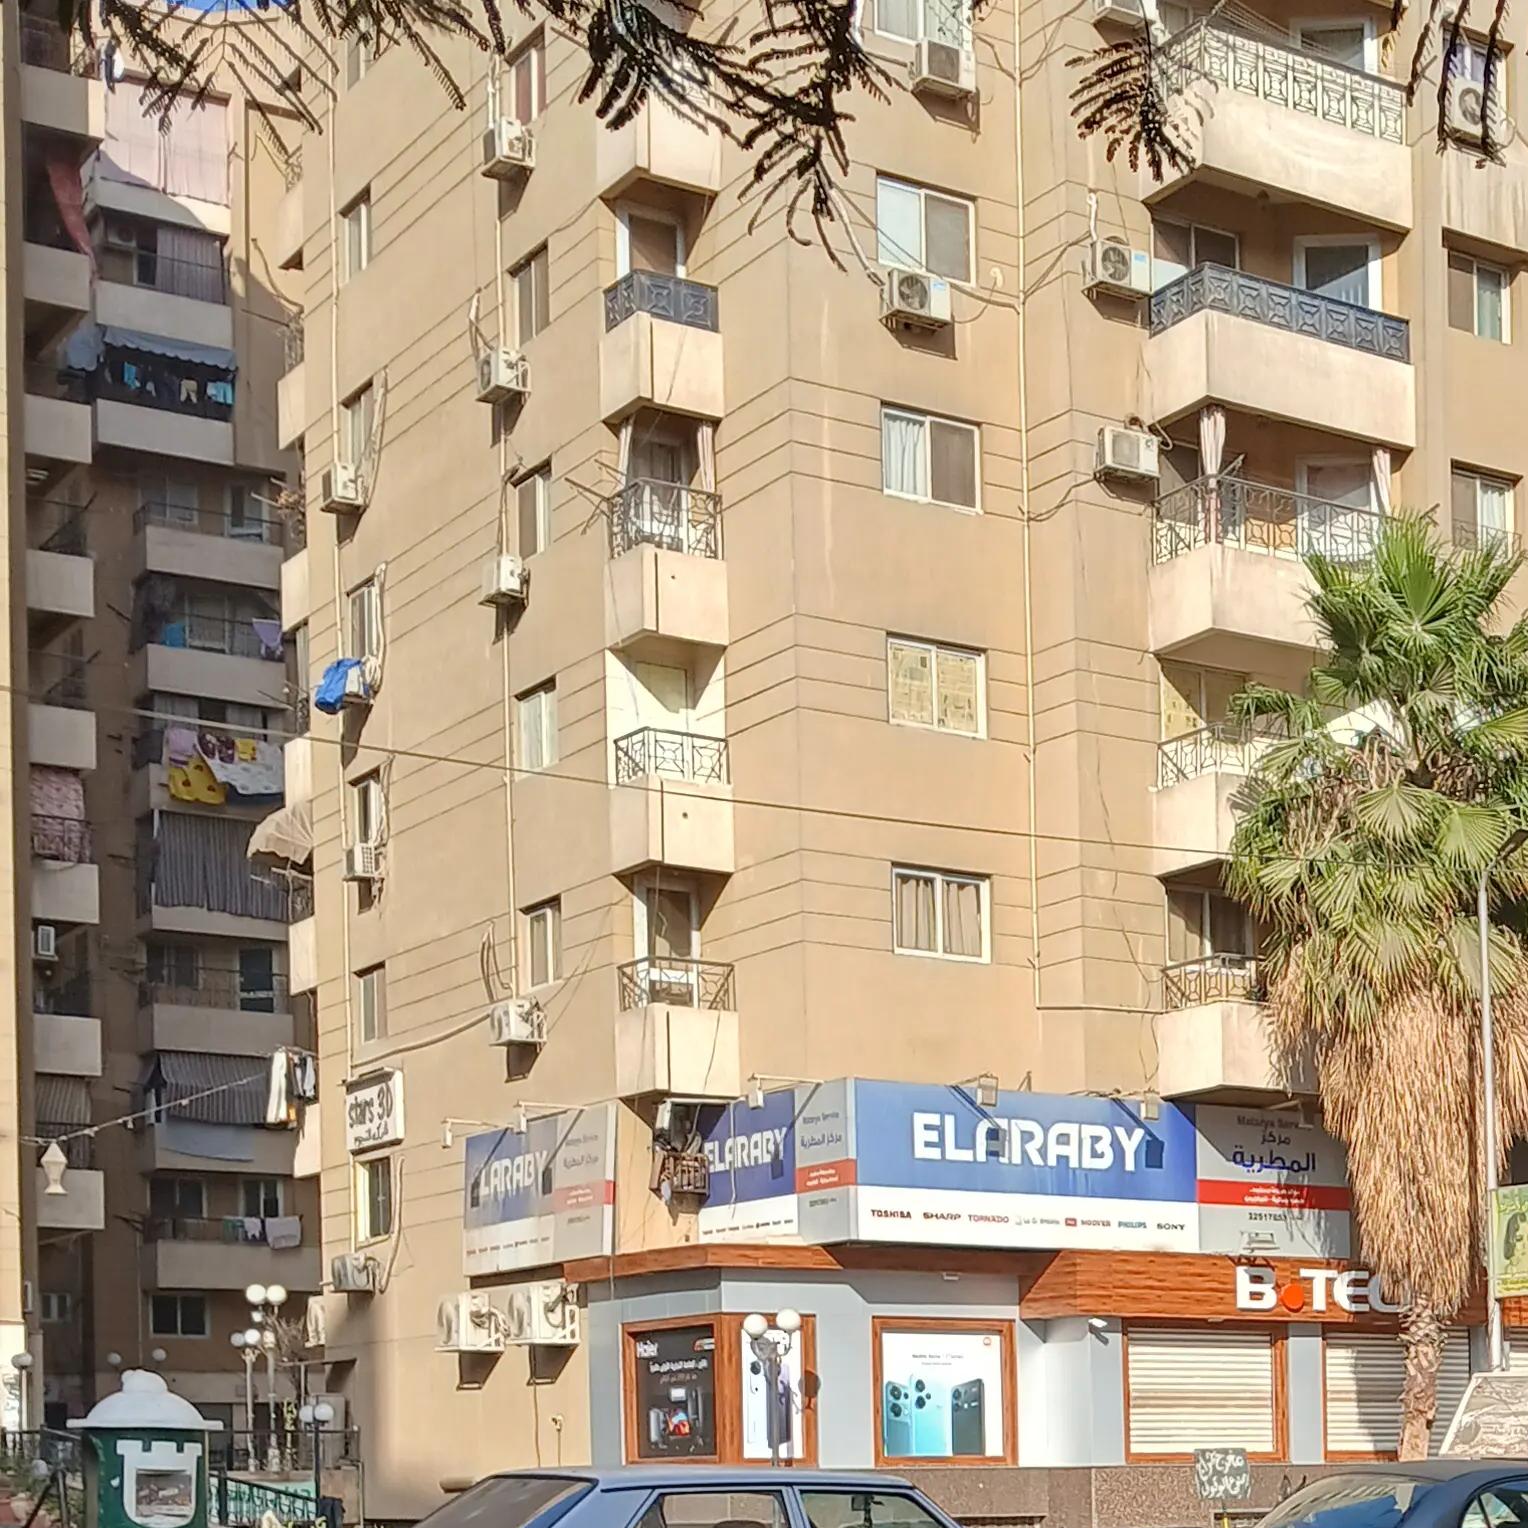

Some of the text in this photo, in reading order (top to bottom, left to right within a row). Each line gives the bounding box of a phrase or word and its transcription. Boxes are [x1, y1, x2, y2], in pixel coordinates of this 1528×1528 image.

[704, 1127, 787, 1173] ELARABY
[912, 1111, 1147, 1172] ELARABY
[1232, 1145, 1316, 1173] المطرية
[472, 1150, 549, 1198] LARABY
[870, 1209, 912, 1219] TOSHIBA
[923, 1212, 961, 1221] SHARP
[968, 1214, 1009, 1223] TORNADO
[1157, 1223, 1185, 1231] SONY
